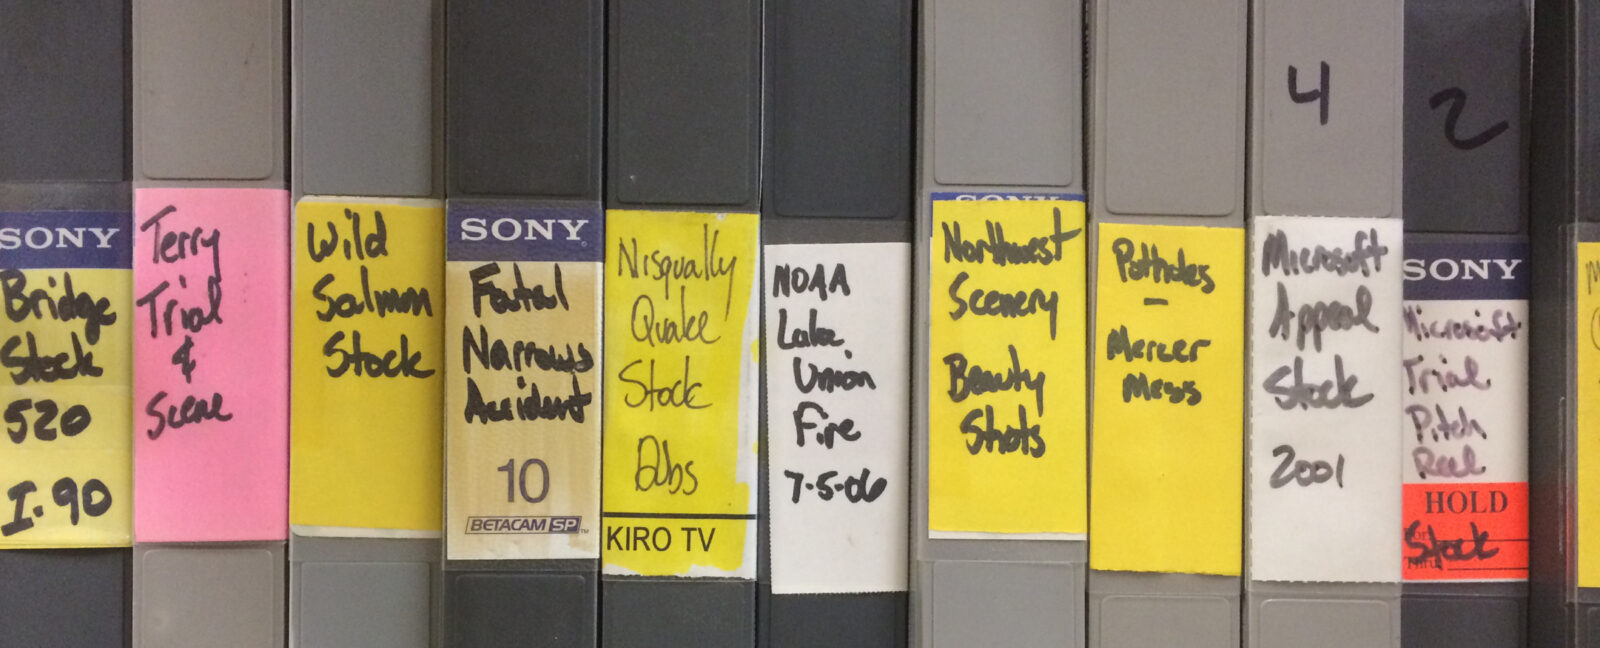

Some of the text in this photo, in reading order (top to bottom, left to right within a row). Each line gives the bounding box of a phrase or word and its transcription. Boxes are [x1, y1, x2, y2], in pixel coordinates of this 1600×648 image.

[1288, 60, 1330, 126] 4
[1429, 87, 1510, 151] 2
[0, 227, 120, 250] SONY
[140, 205, 222, 283] Terry
[307, 208, 388, 263] Wild
[461, 217, 589, 241] SONY
[941, 207, 1082, 267] Northwest
[1262, 228, 1389, 277] Microsoft
[468, 262, 569, 318] Fatal
[618, 223, 738, 322] Nisqually
[772, 263, 851, 301] NOAA
[1112, 237, 1215, 294] Potholes
[1403, 258, 1522, 281] SONY
[0, 269, 117, 345] Bridge
[136, 275, 224, 338] Trial
[312, 265, 433, 322] Salmon
[631, 285, 721, 347] Quake
[949, 271, 1059, 341] Scenery
[1269, 281, 1380, 353] Appeal
[323, 330, 436, 378] Stock
[462, 324, 595, 375] Narrows
[776, 308, 845, 350] Lake
[1106, 324, 1212, 362] Mercer
[0, 331, 104, 385] Stock
[618, 355, 713, 411] Stock
[793, 349, 877, 394] Union
[942, 344, 1046, 418] Beauty
[1263, 354, 1375, 410] Stock
[1402, 355, 1491, 395] Trial
[464, 375, 593, 425] Accident
[1122, 372, 1202, 406] Mess
[4, 399, 92, 444] 520
[147, 391, 233, 440] Scene
[792, 401, 862, 449] Fire
[960, 404, 1046, 458] Shots
[1405, 404, 1487, 442] Pitch
[497, 458, 550, 504] 10
[1269, 444, 1345, 488] 2001
[1412, 444, 1487, 479] Reel
[470, 518, 547, 532] BETACAM
[551, 518, 578, 532] SP
[1425, 490, 1508, 514] HOLD
[606, 526, 716, 552] KIRO TV
[1404, 520, 1499, 571] Stock
